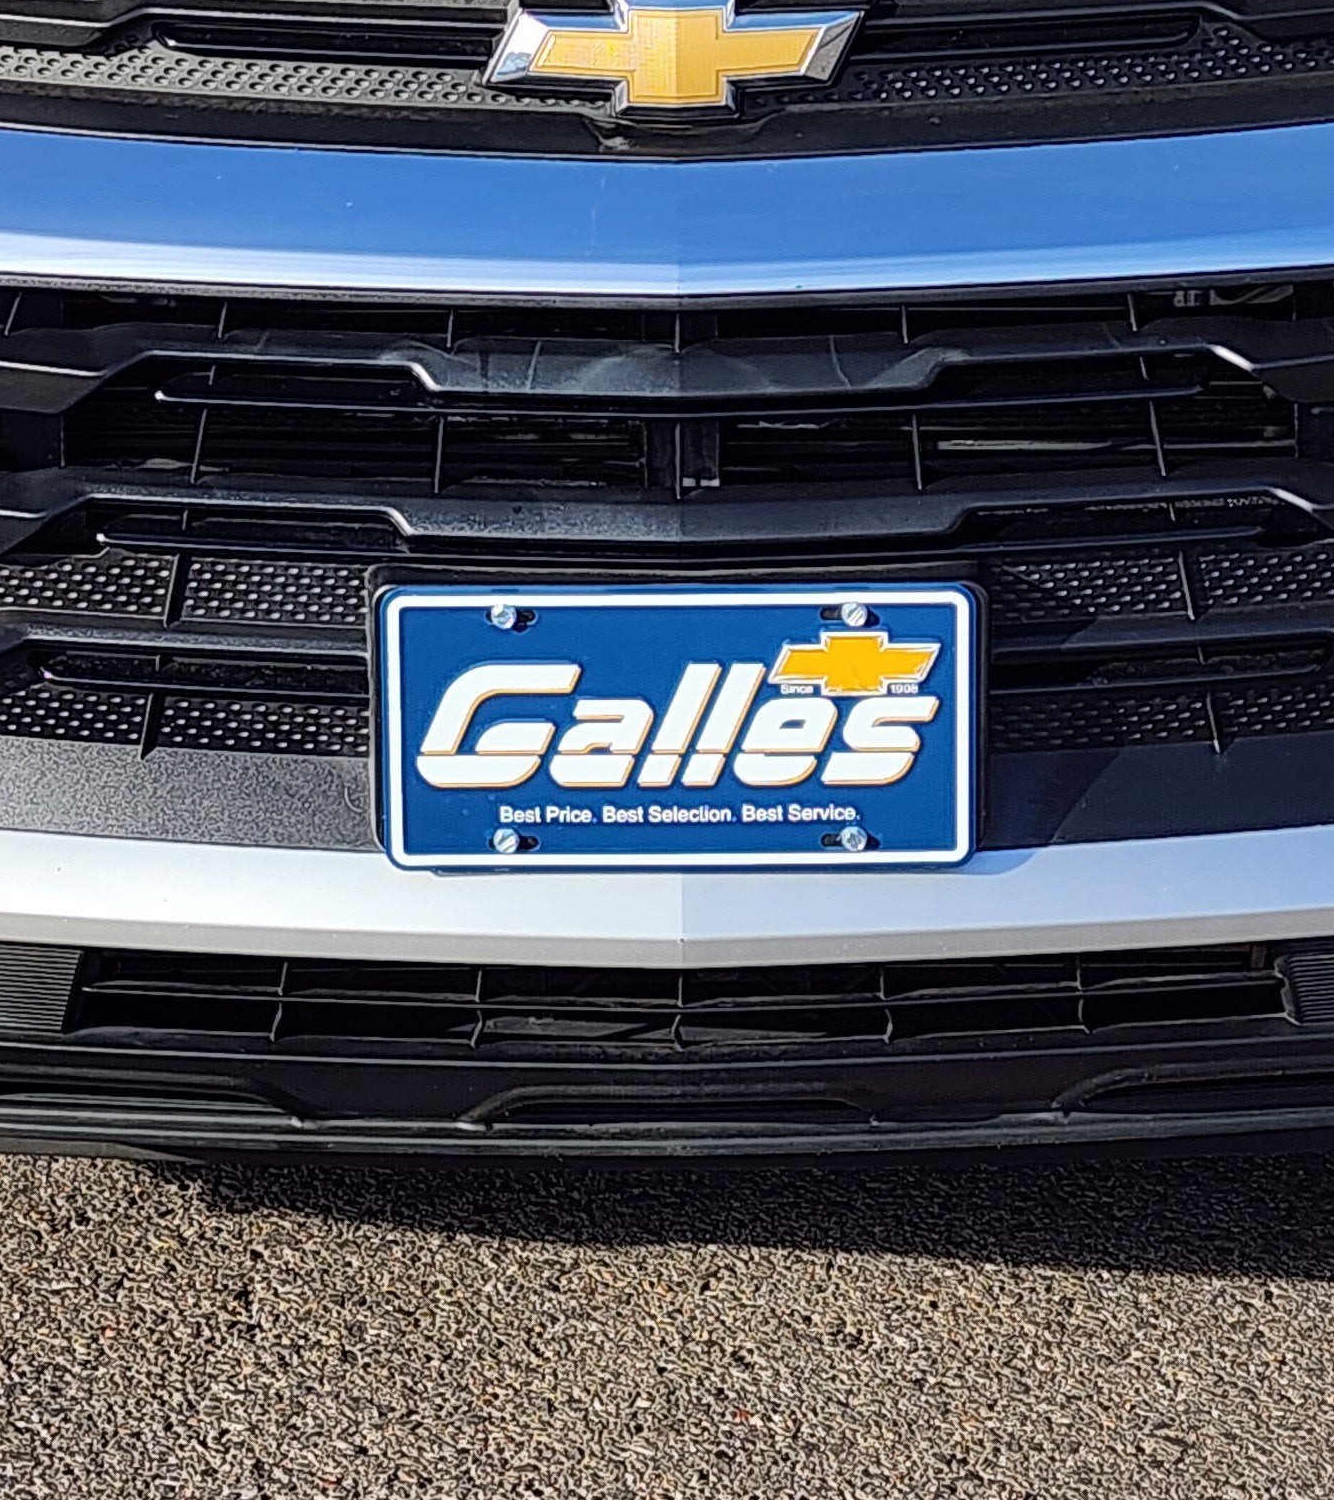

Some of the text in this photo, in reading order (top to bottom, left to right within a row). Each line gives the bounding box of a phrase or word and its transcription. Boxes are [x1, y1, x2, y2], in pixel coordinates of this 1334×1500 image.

[780, 684, 814, 694] Since
[416, 662, 940, 789] Galles
[499, 803, 861, 823] Best Price. Best Selection. Best Service.
